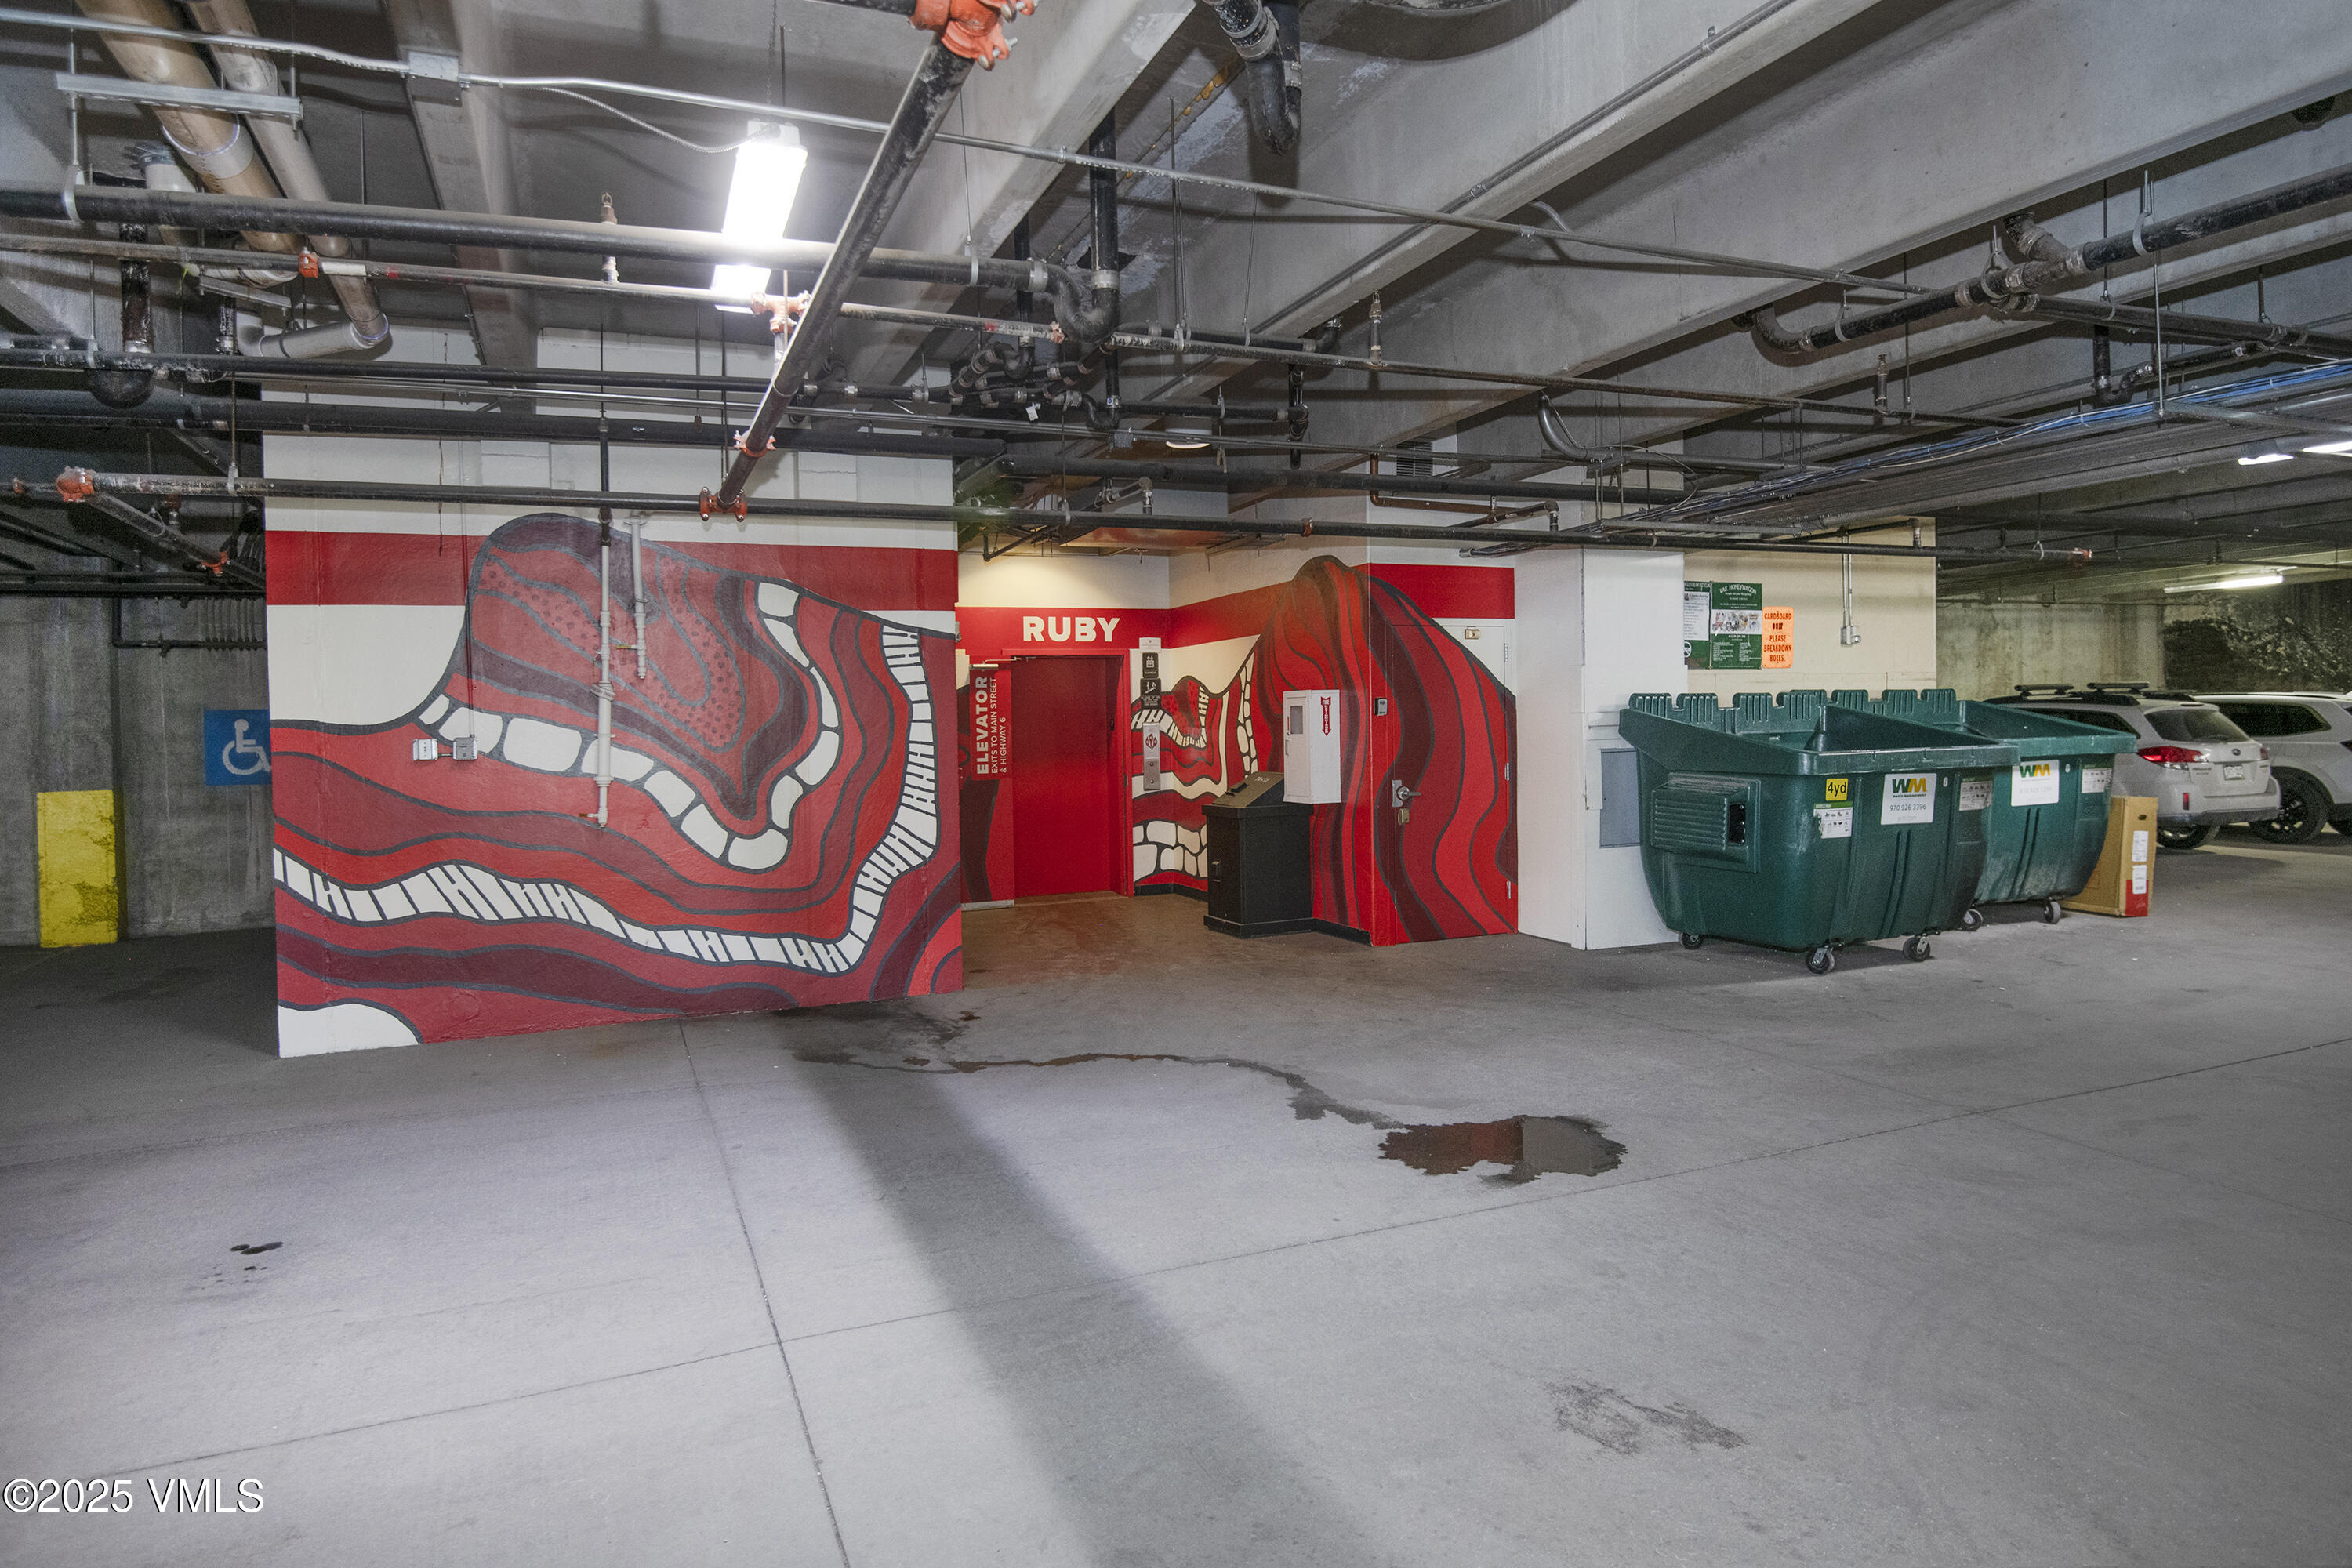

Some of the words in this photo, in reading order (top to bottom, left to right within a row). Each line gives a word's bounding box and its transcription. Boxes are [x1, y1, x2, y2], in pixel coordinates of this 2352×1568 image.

[1023, 616, 1120, 642] RUBY
[975, 677, 989, 775] ELEVATOR
[990, 735, 998, 748] TO
[2020, 764, 2051, 778] WM
[1827, 782, 1847, 797] 4yd
[1892, 778, 1926, 793] WM
